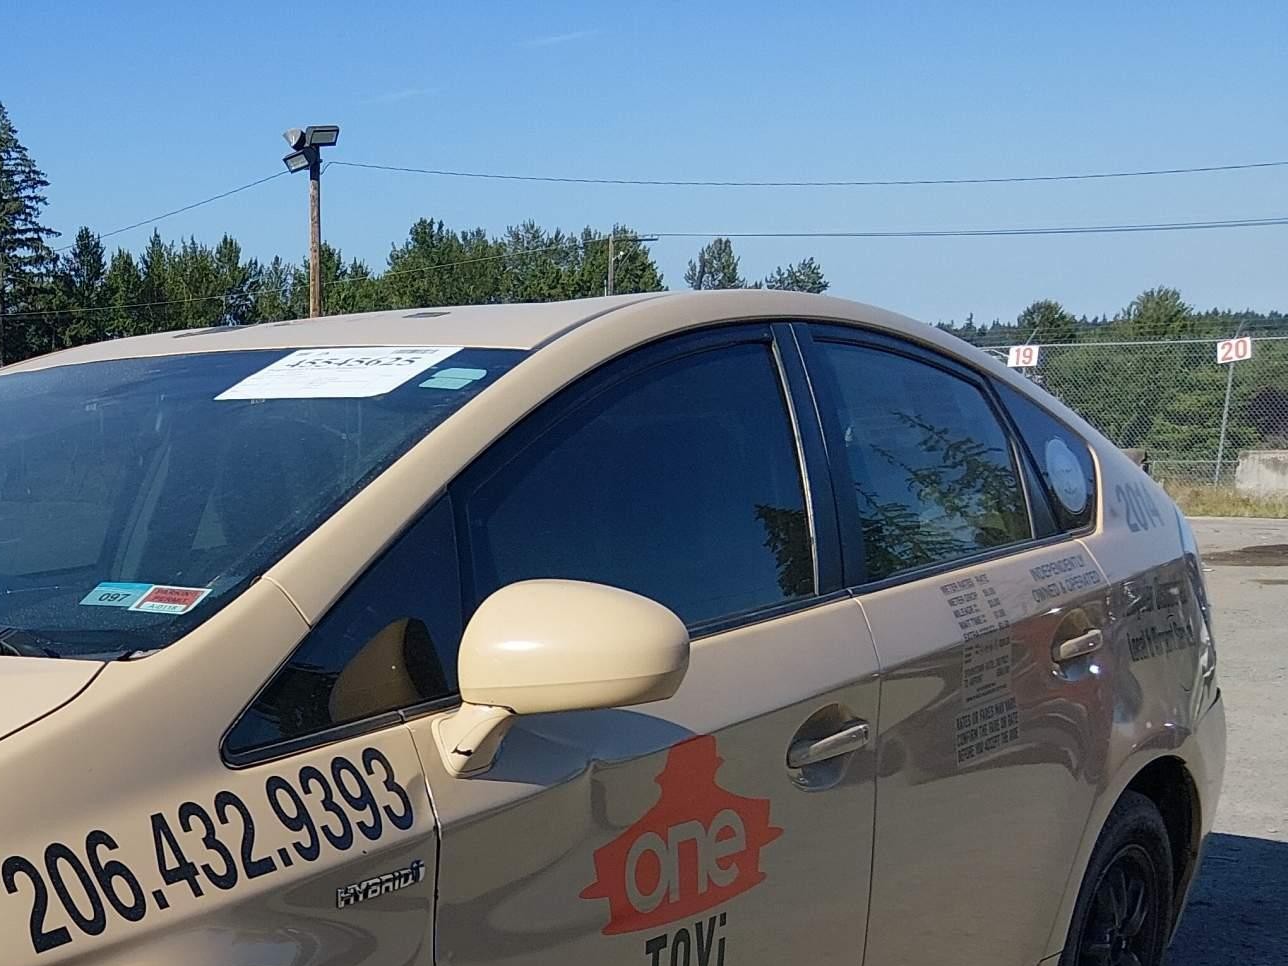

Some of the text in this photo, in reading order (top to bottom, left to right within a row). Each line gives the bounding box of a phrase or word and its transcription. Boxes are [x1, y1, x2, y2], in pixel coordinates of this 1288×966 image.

[1014, 347, 1033, 365] 19
[1221, 340, 1247, 360] 20
[1115, 482, 1165, 533] 2014
[98, 592, 131, 602] 097
[2, 747, 414, 954] 206.432.9393
[624, 808, 746, 913] one
